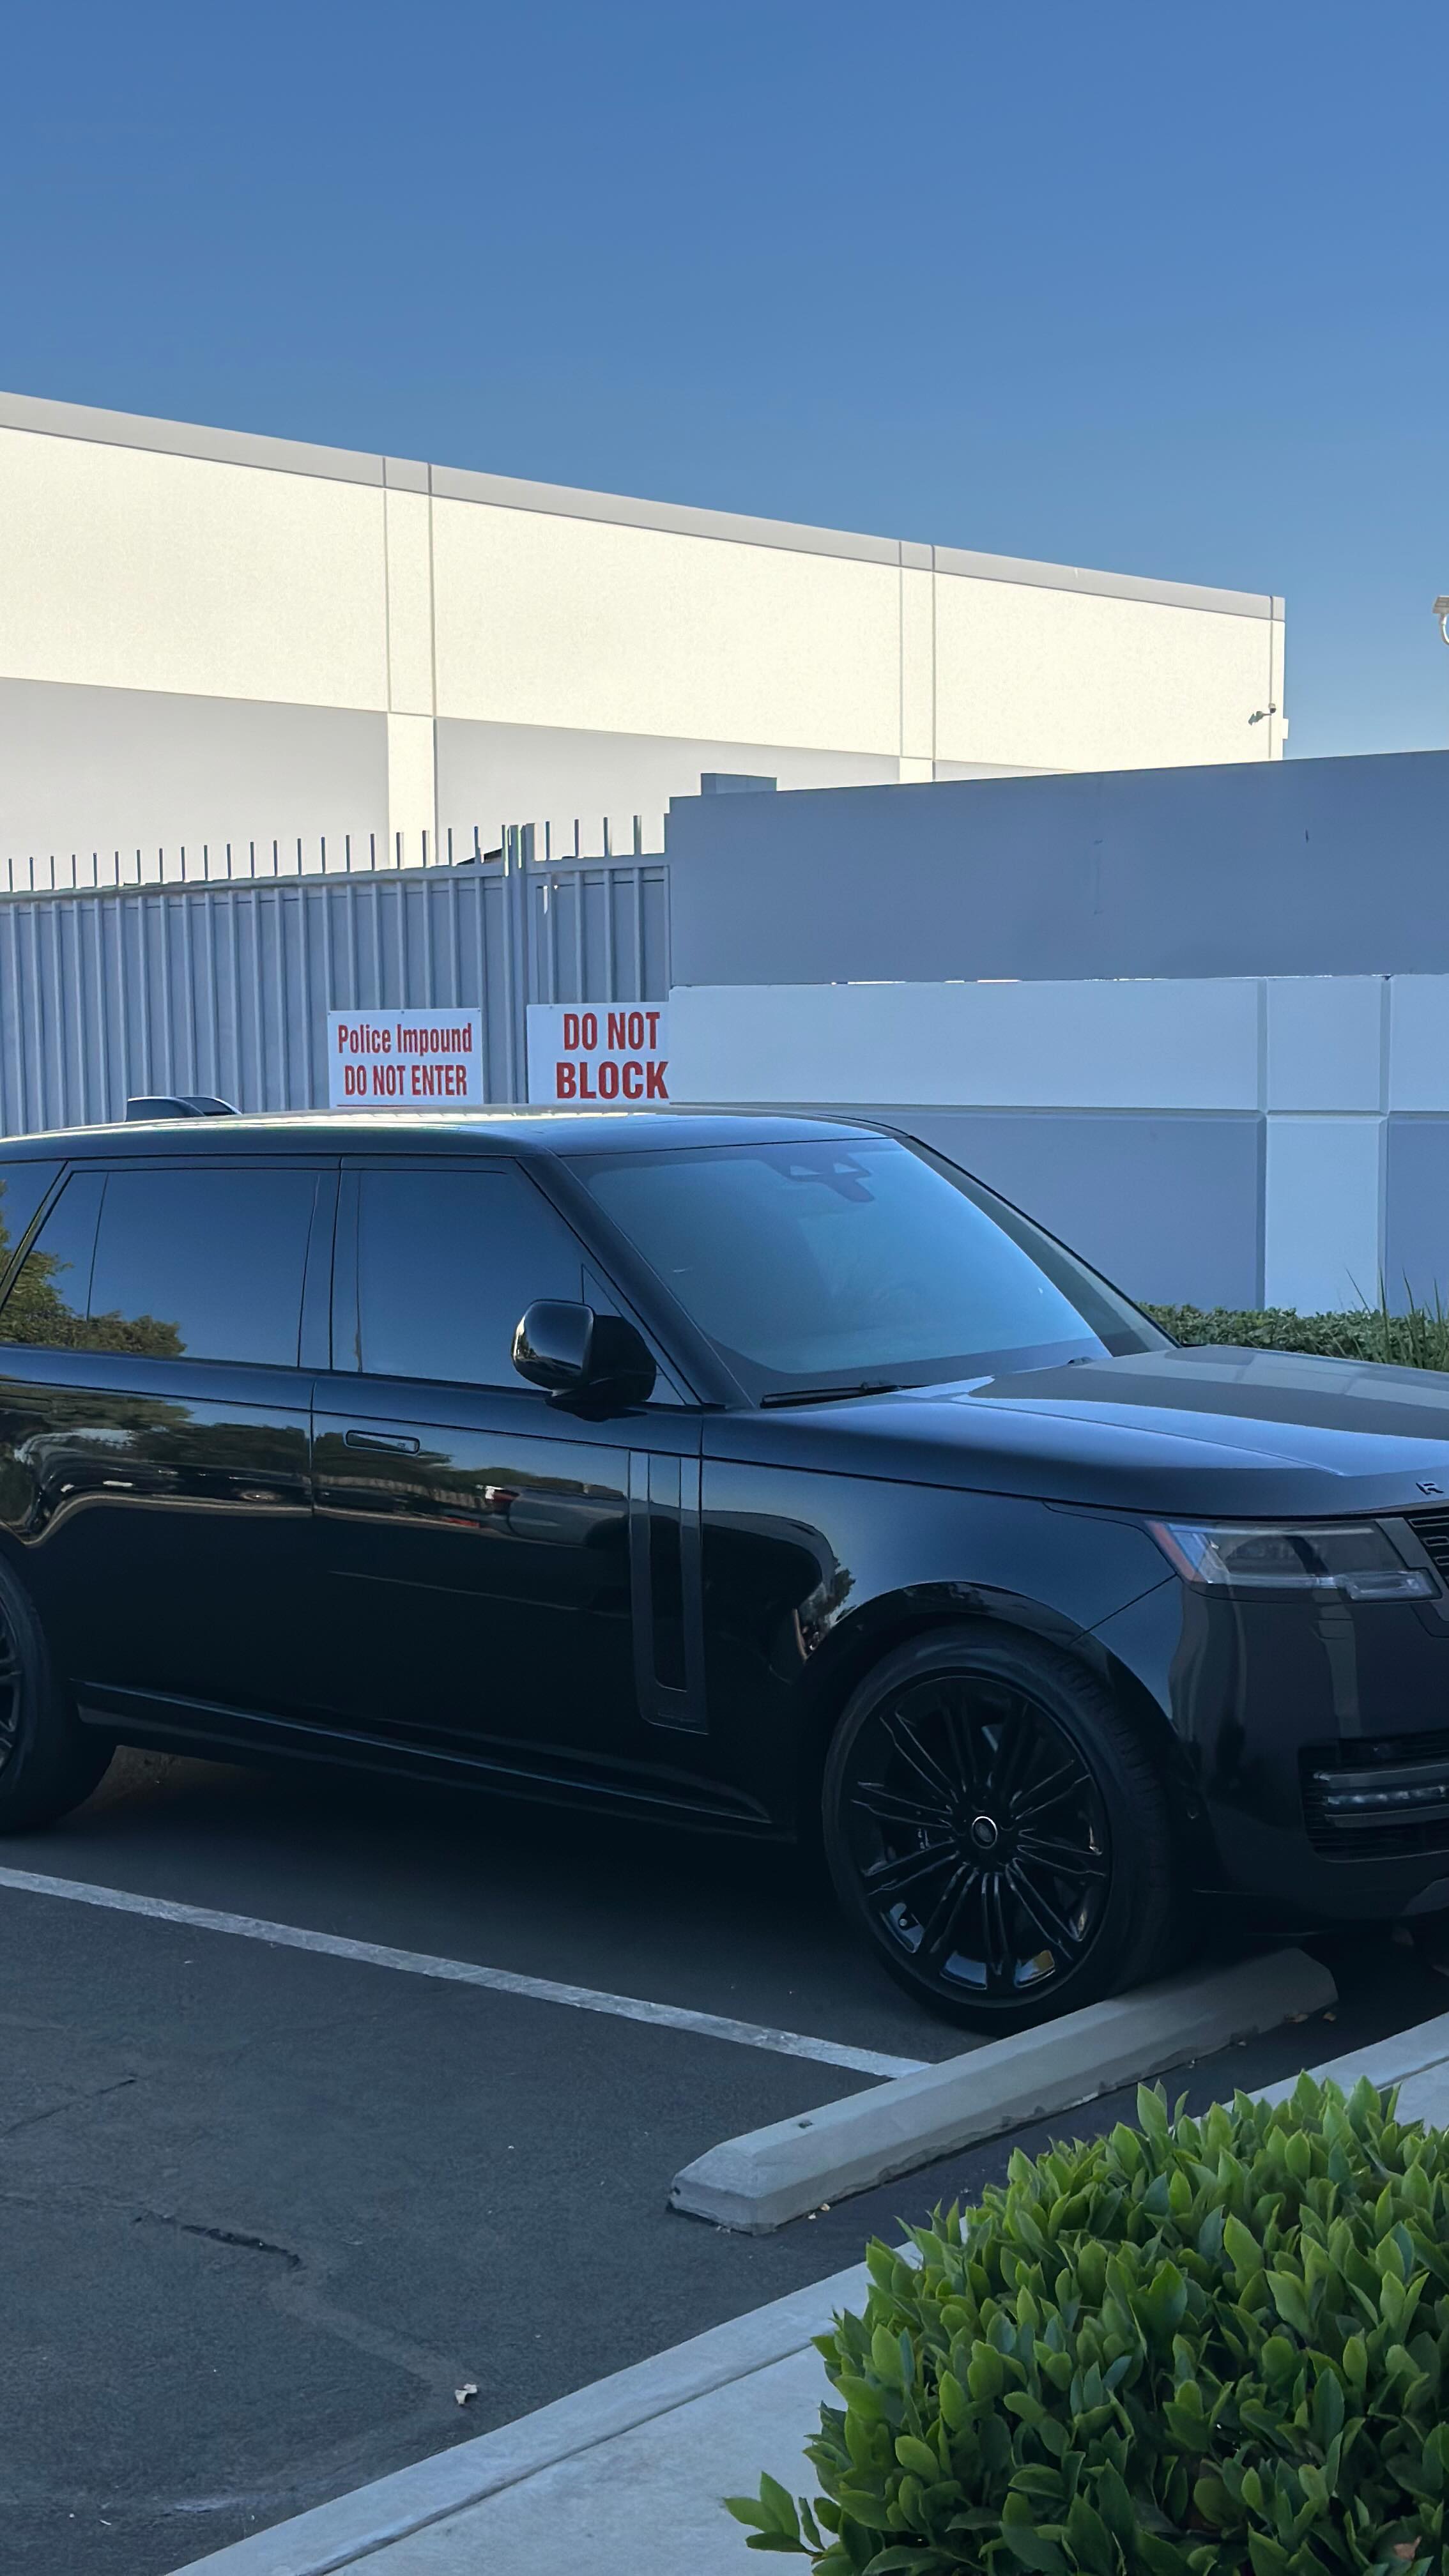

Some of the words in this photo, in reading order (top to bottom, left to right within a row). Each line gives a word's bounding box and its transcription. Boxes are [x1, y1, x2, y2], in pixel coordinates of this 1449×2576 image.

[338, 1024, 391, 1054] Police
[397, 1023, 472, 1057] Impound
[564, 1013, 597, 1050] DO
[608, 1011, 660, 1050] NOT
[345, 1065, 367, 1096] DO
[372, 1065, 405, 1096] NOT
[411, 1064, 467, 1096] ENTER
[556, 1061, 669, 1100] BLOCK
